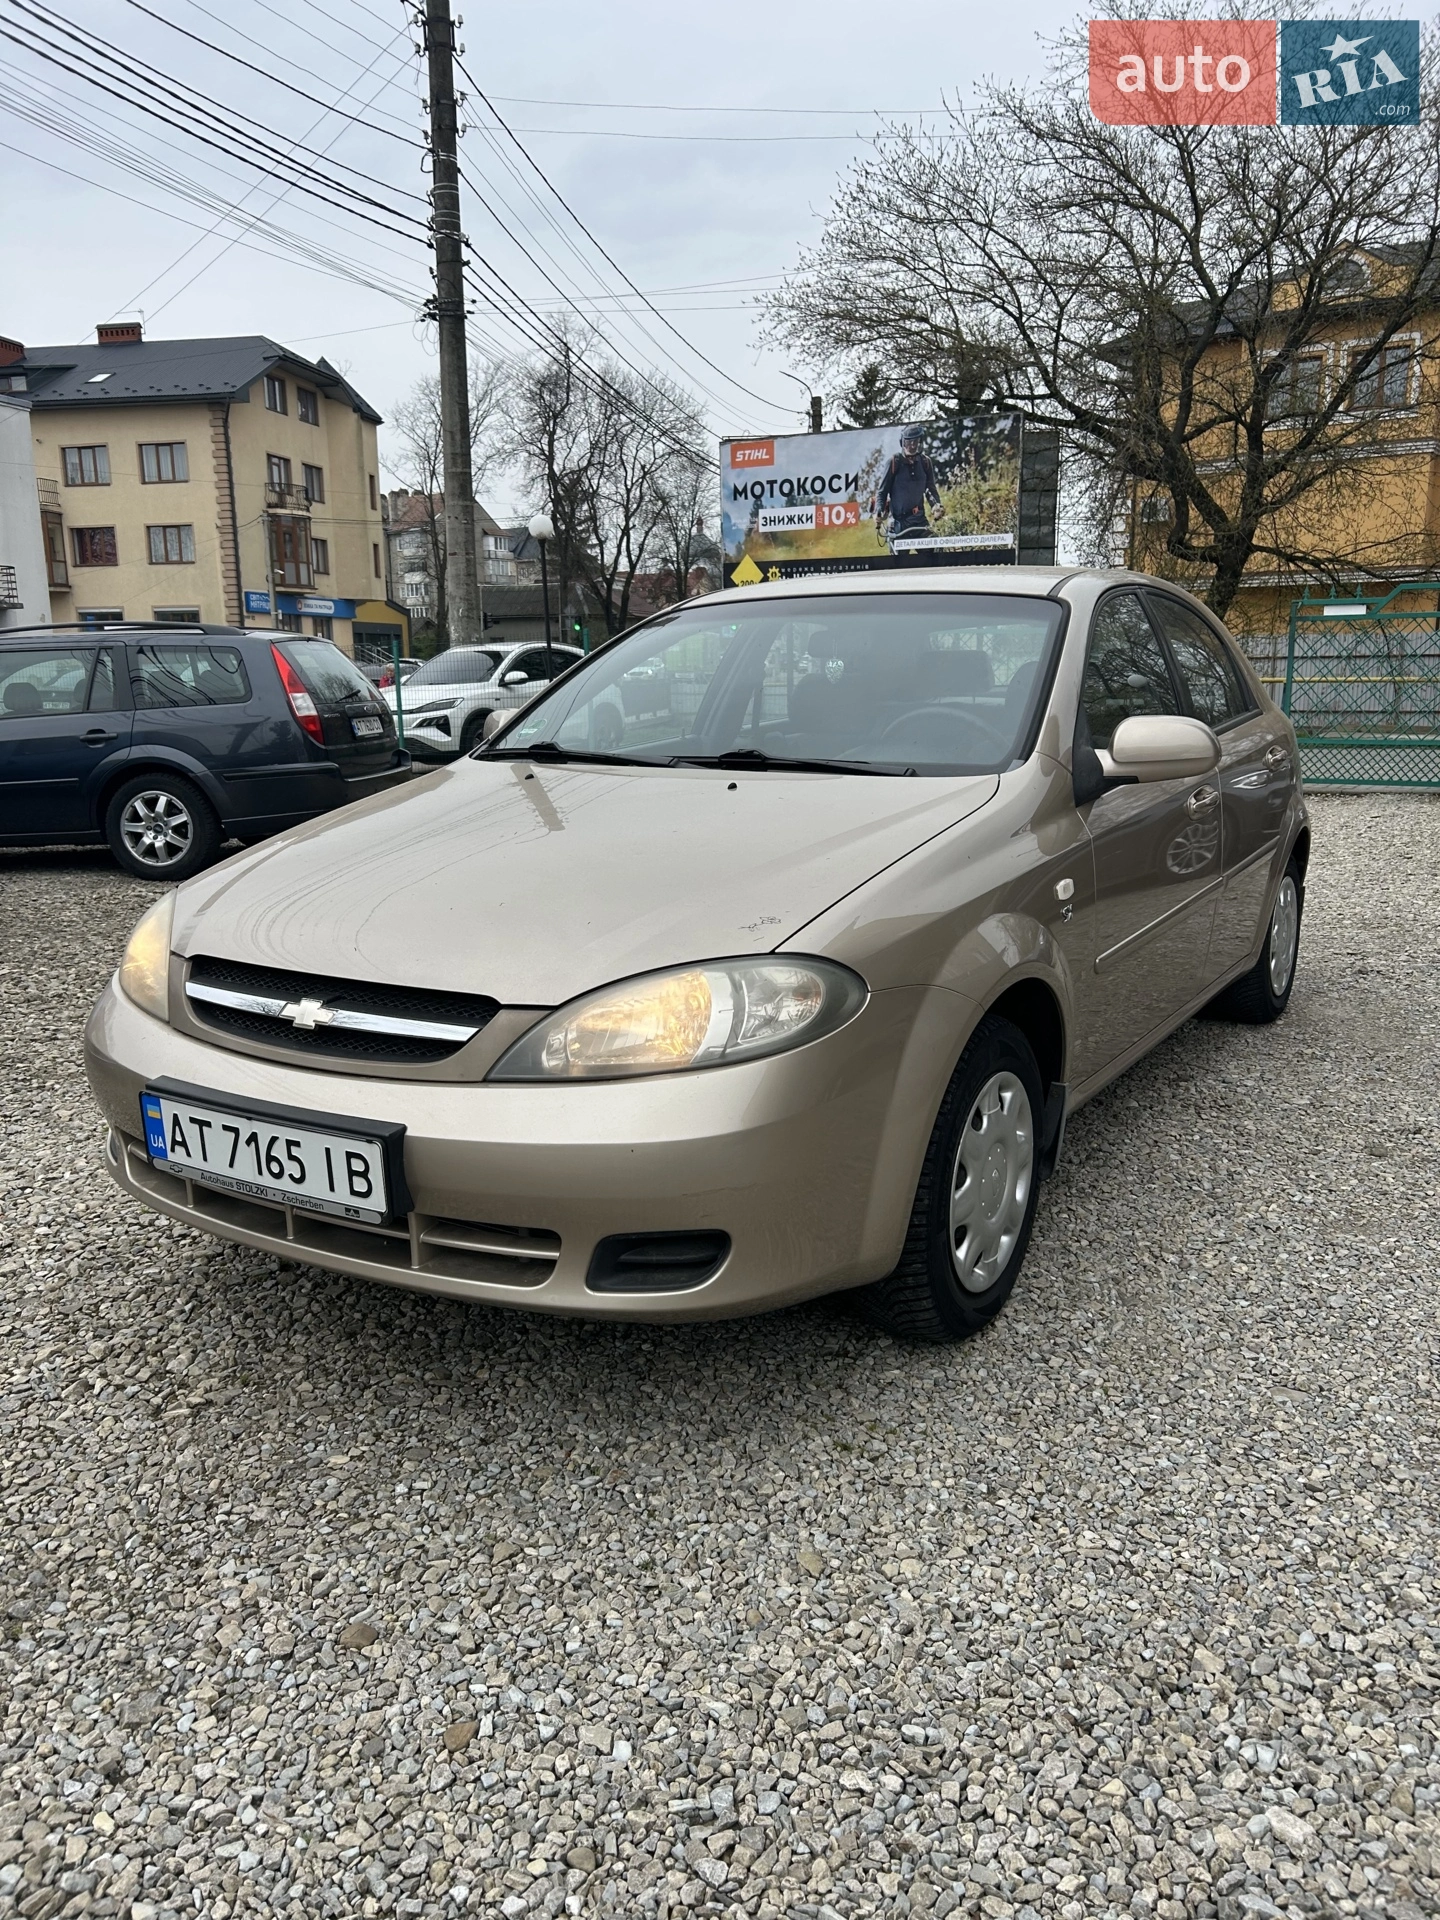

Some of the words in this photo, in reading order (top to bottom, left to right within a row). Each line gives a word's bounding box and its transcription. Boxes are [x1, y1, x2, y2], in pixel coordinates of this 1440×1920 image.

[735, 448, 770, 462] STIHL
[733, 472, 859, 501] МОТОКОСИ
[761, 513, 814, 527] ЗНИЖКИ
[822, 505, 856, 526] 10%
[939, 537, 980, 545] ОФІЦІЙНОГО
[150, 1134, 166, 1150] UA
[170, 1112, 212, 1163] AT
[221, 1124, 307, 1184] 7165
[324, 1146, 373, 1198] IB
[200, 1172, 235, 1189] Autohaus
[235, 1182, 268, 1198] STOLZKI
[281, 1192, 324, 1211] Zscherben
